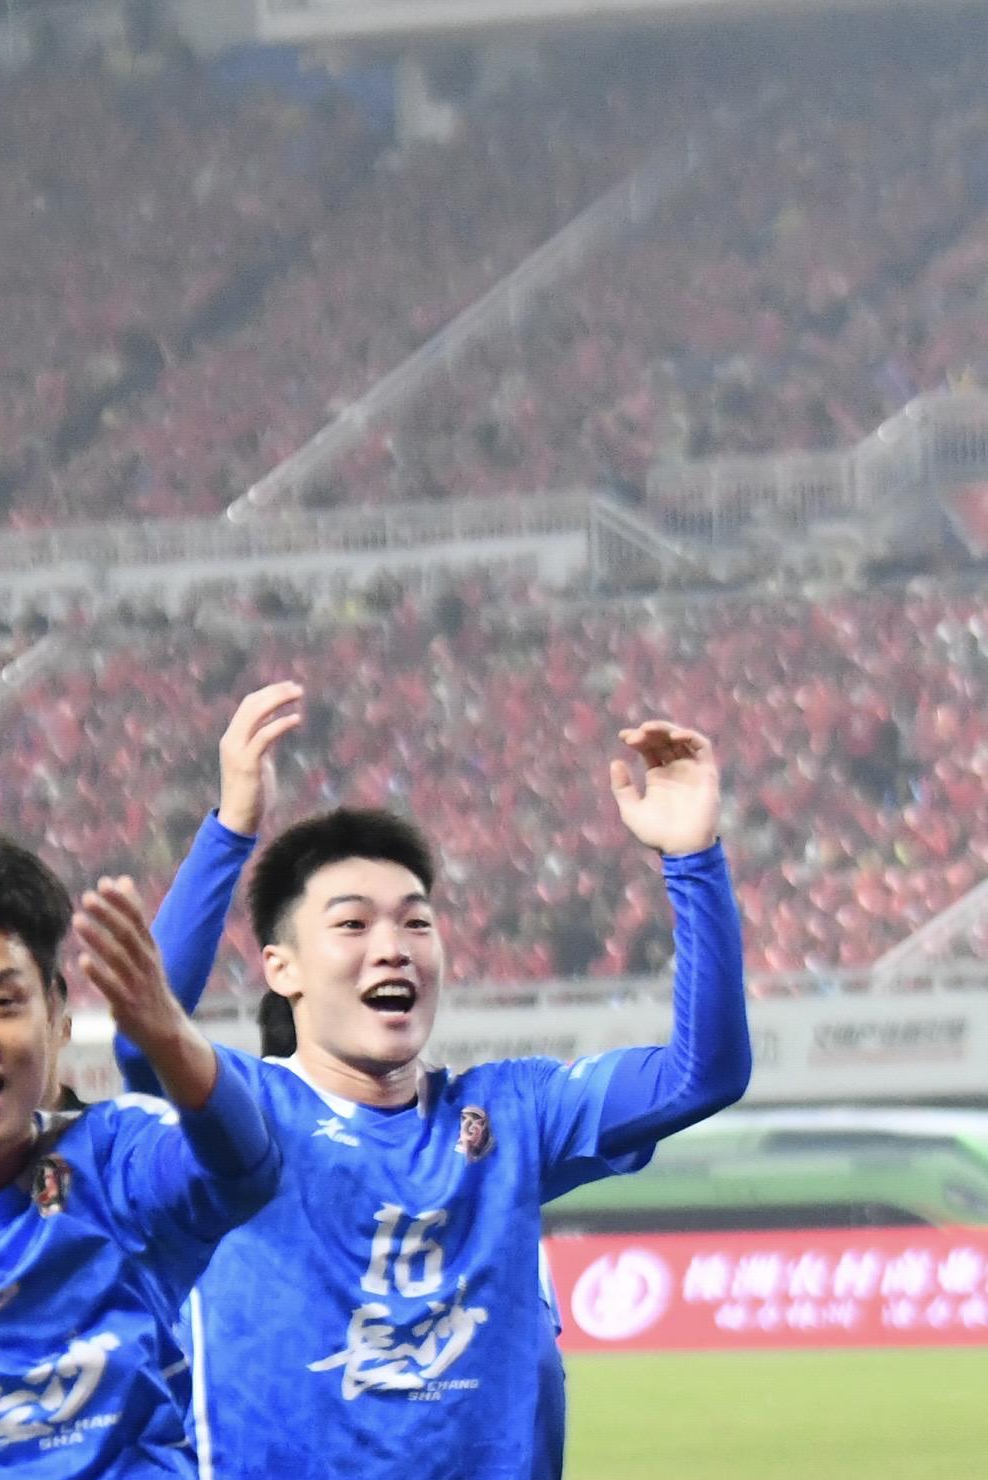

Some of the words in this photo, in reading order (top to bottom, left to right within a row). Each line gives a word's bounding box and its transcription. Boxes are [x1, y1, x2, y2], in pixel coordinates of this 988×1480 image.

[360, 1202, 447, 1298] 16
[408, 1390, 442, 1402] SHA
[38, 1432, 84, 1452] SHA
